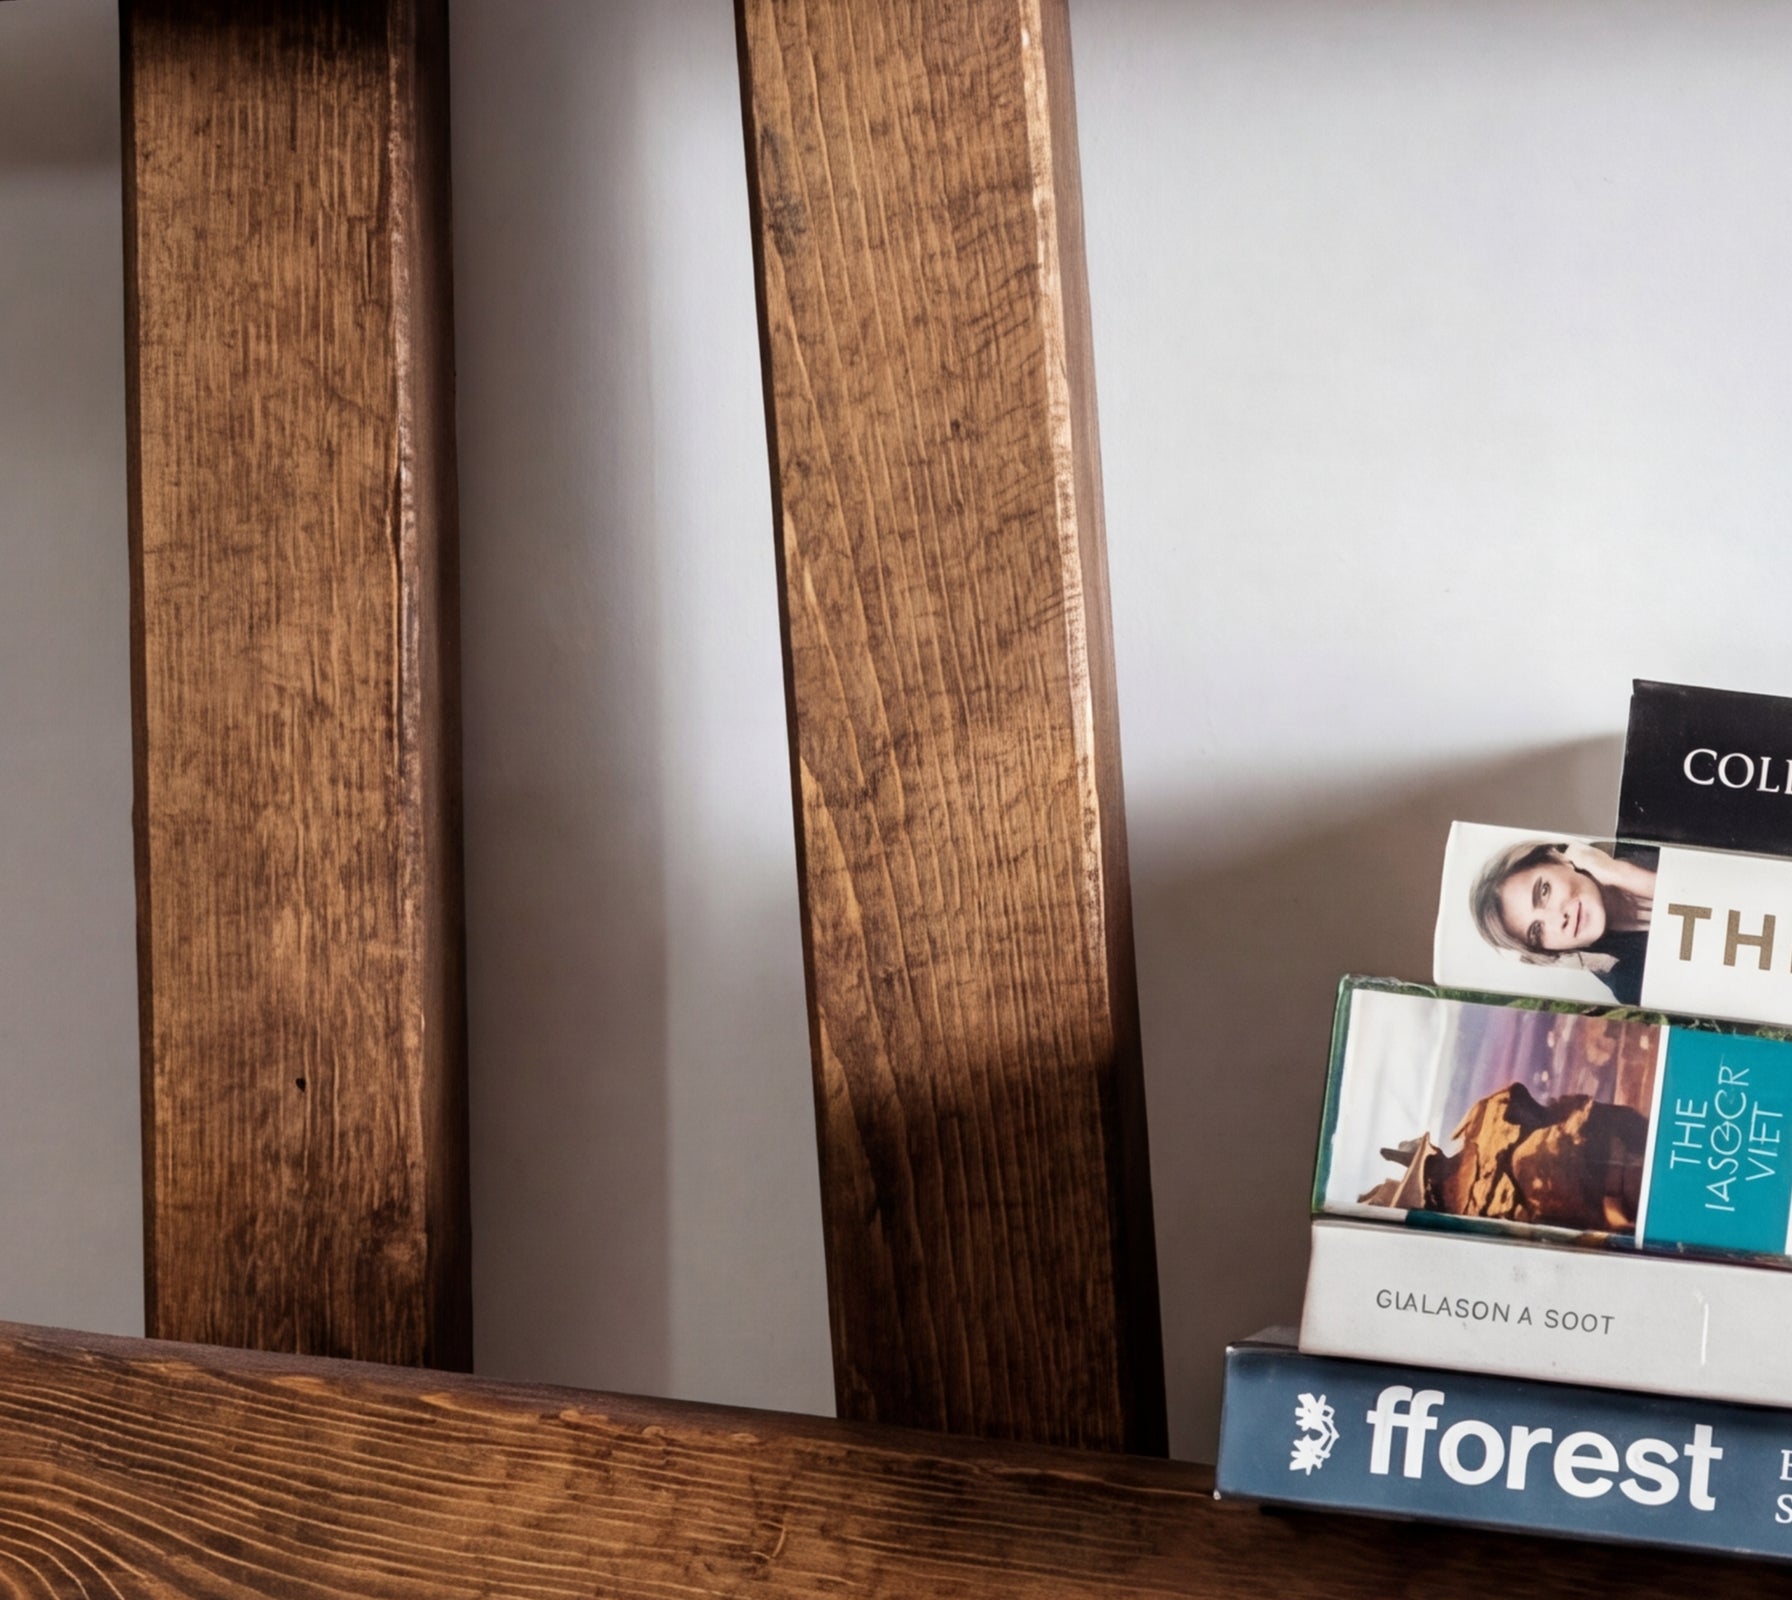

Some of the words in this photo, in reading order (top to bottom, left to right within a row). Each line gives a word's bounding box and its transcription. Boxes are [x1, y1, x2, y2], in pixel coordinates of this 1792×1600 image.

[1669, 1098, 1708, 1169] THE
[1544, 1308, 1616, 1336] SOOT
[1366, 1384, 1724, 1513] fforest
